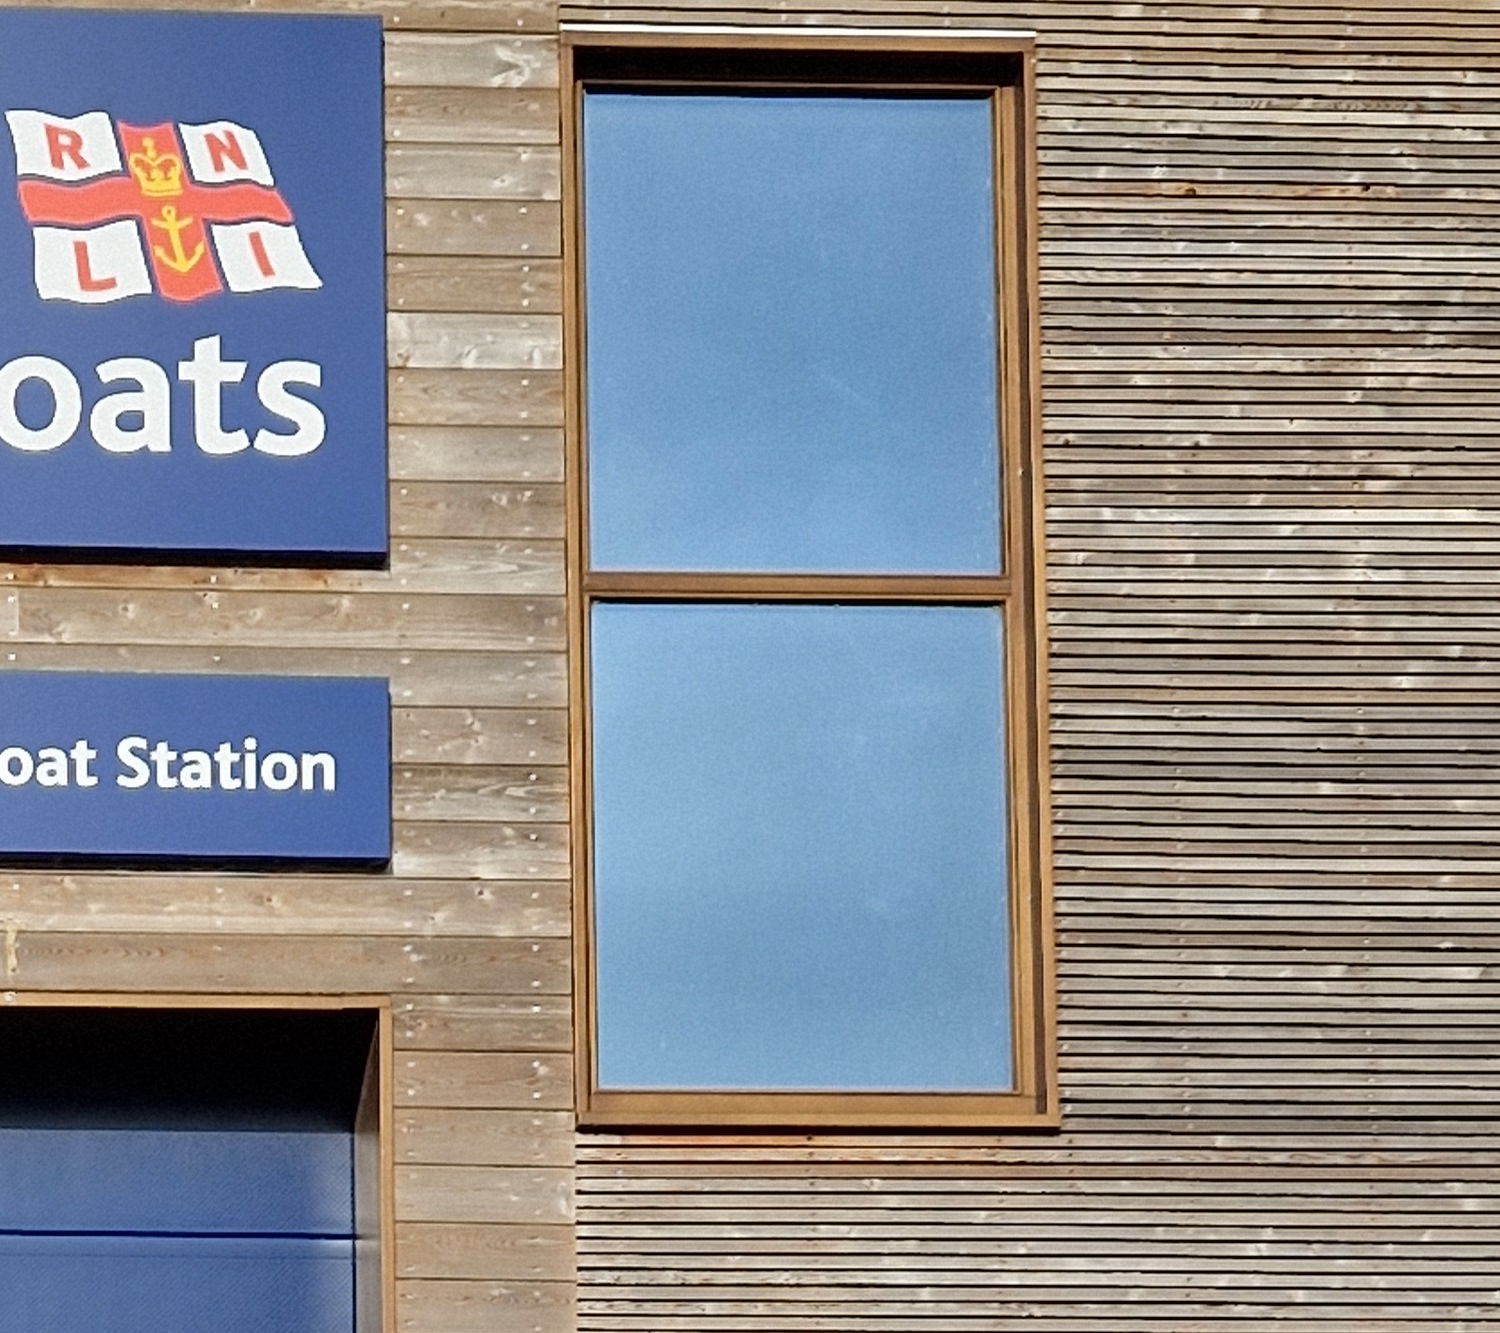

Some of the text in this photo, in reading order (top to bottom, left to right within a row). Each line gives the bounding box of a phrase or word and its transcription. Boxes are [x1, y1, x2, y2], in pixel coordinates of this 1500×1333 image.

[44, 123, 248, 174] R N
[73, 231, 275, 293] L I
[115, 735, 337, 793] Station
